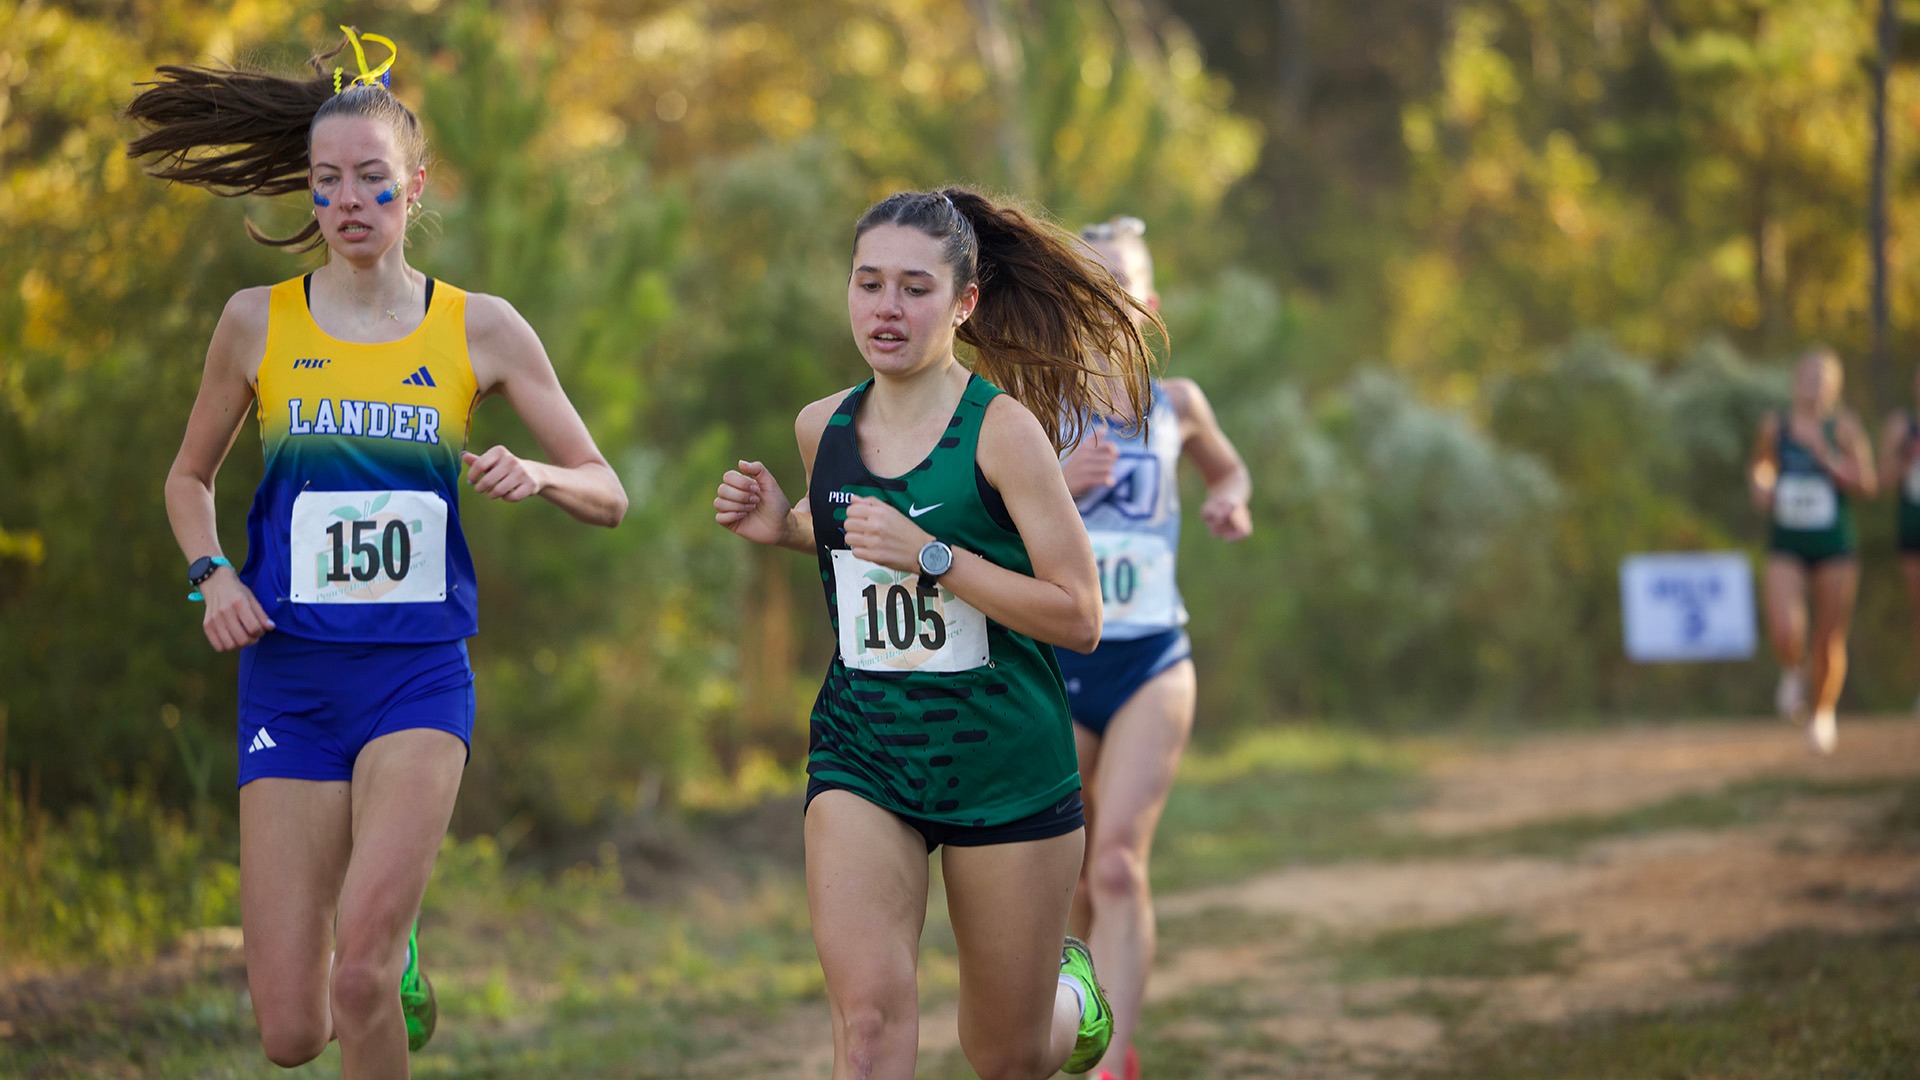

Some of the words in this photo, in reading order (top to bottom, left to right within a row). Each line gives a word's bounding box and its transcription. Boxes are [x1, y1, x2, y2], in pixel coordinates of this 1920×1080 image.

[292, 358, 332, 370] PBC
[289, 398, 440, 444] LANDER
[325, 519, 411, 582] 150
[861, 584, 946, 651] 105
